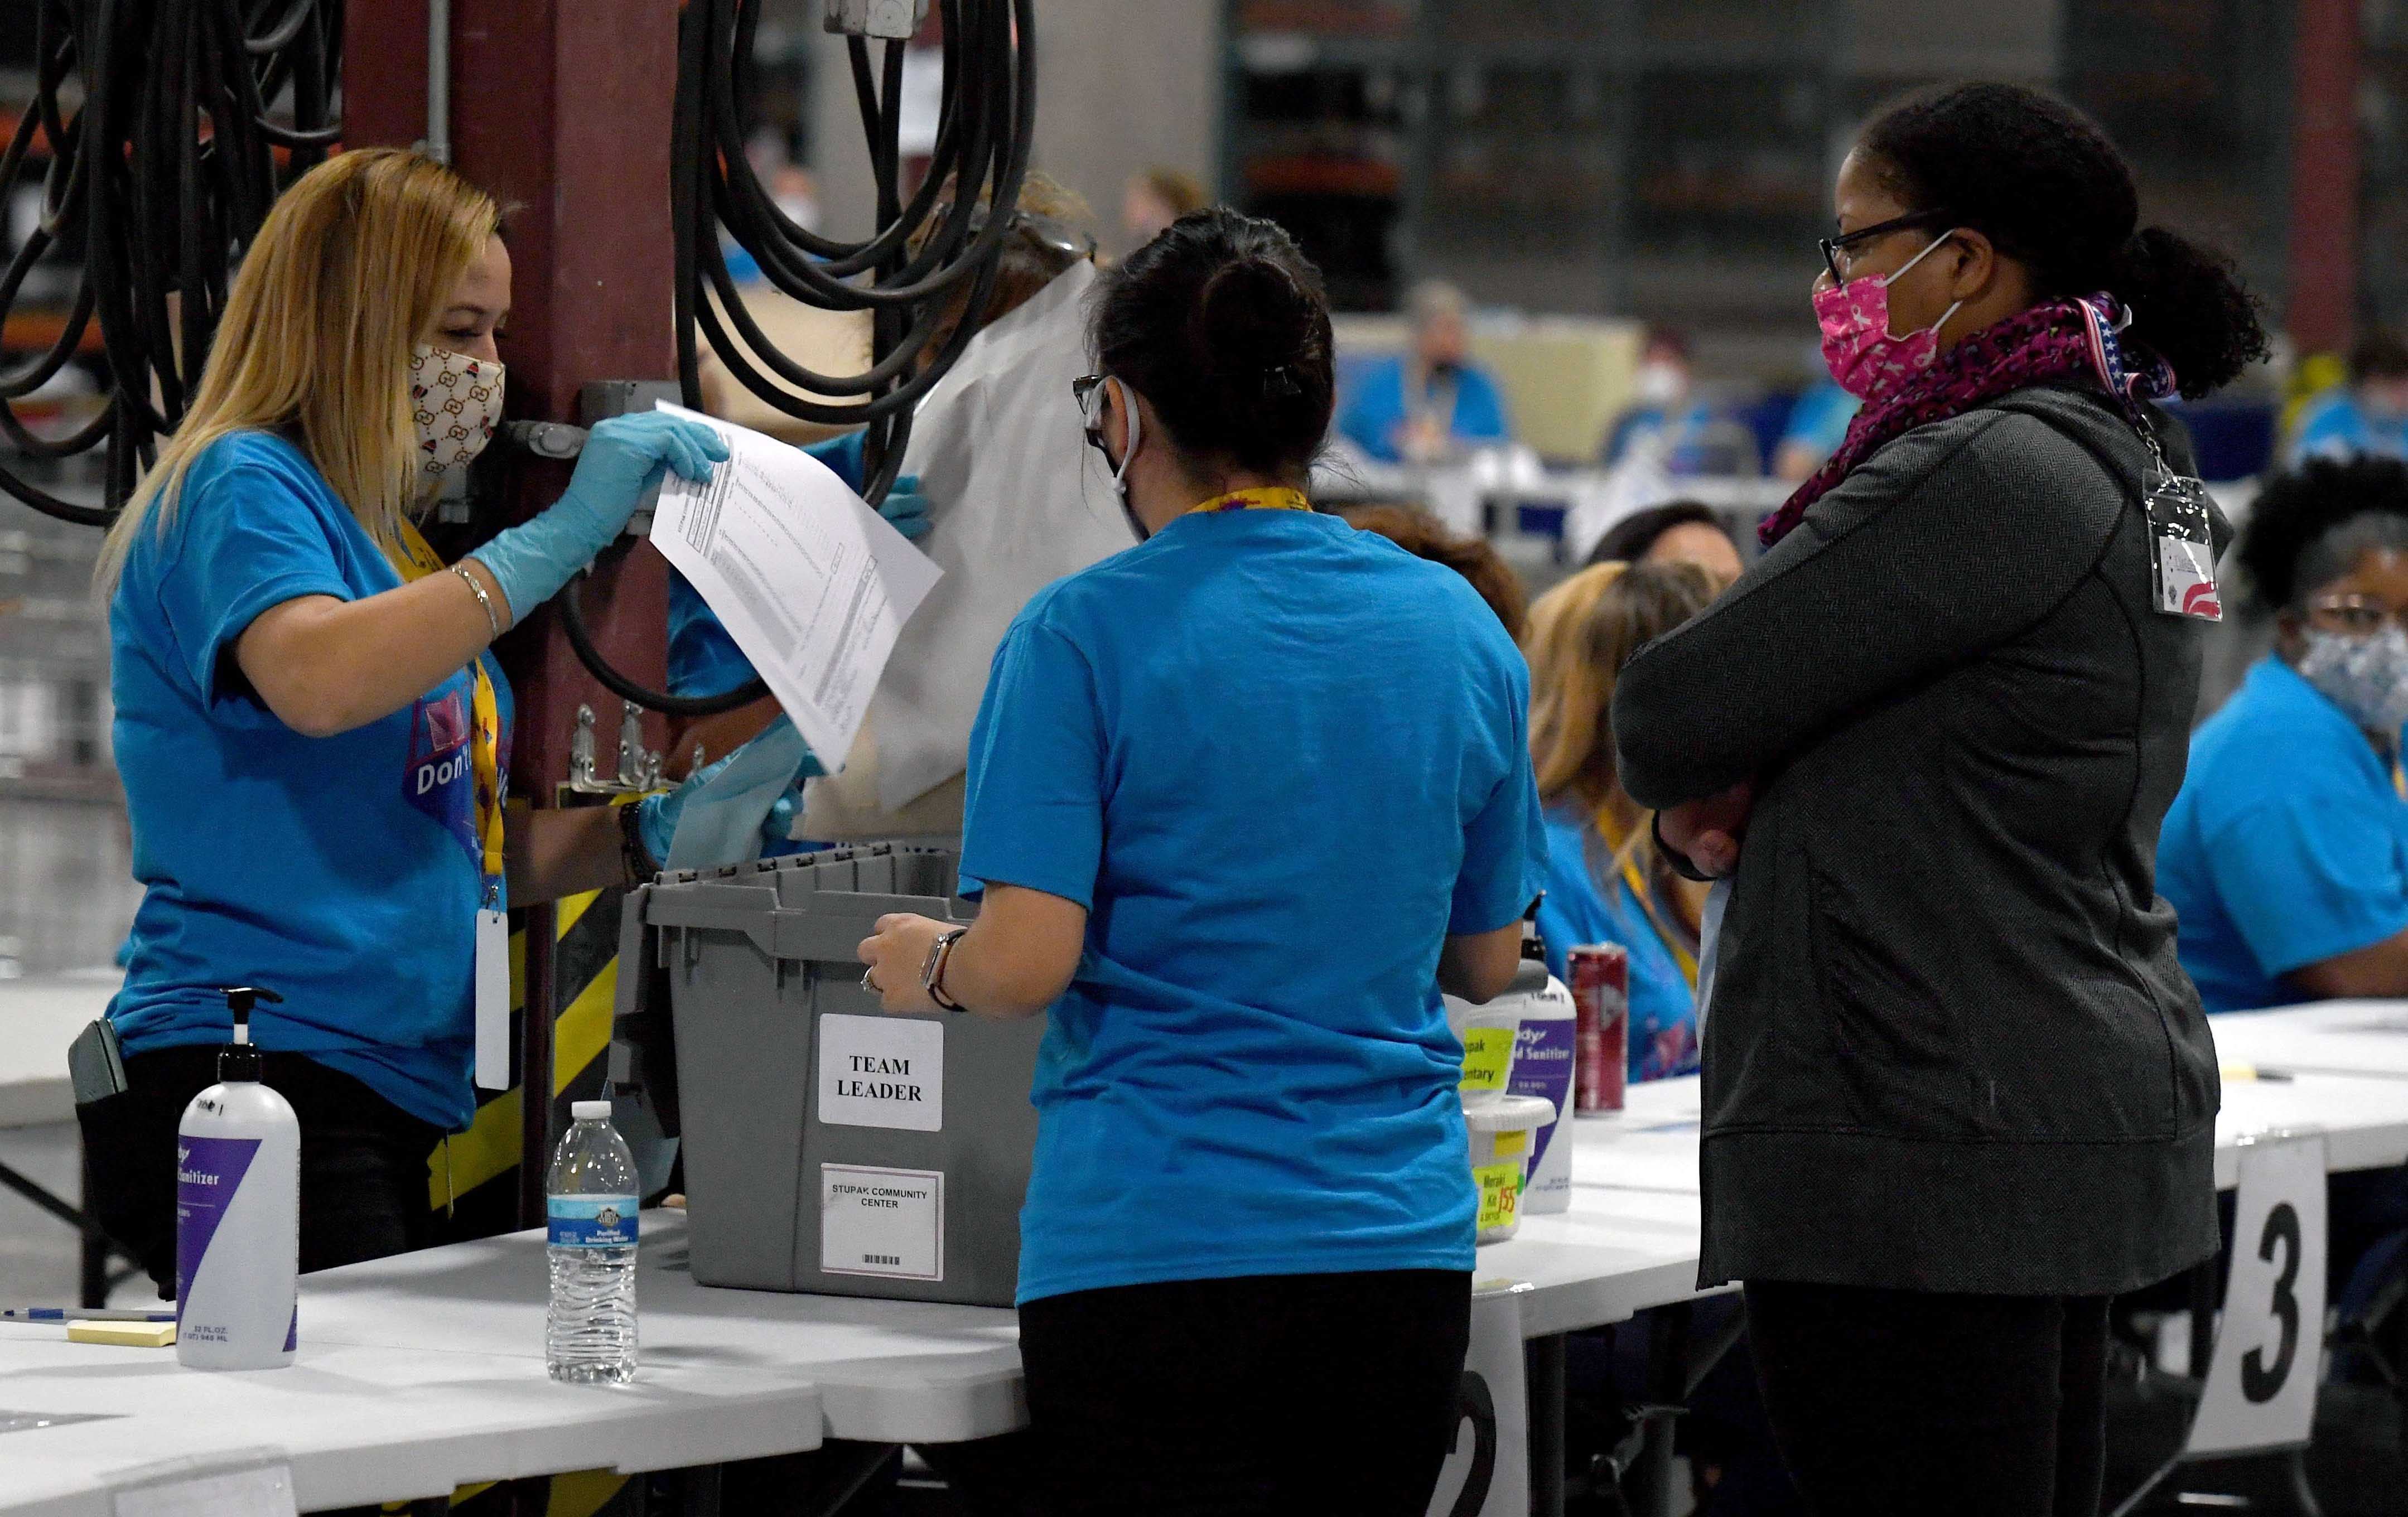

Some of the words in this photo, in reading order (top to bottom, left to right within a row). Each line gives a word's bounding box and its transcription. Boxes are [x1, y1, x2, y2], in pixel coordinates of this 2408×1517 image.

[850, 1055, 910, 1075] TEAM
[837, 1080, 922, 1101] LEADER
[832, 1184, 869, 1195] STUPAK
[872, 1187, 927, 1199] COMMUNITY
[861, 1198, 899, 1209] CENTER
[2241, 1200, 2301, 1405] 3
